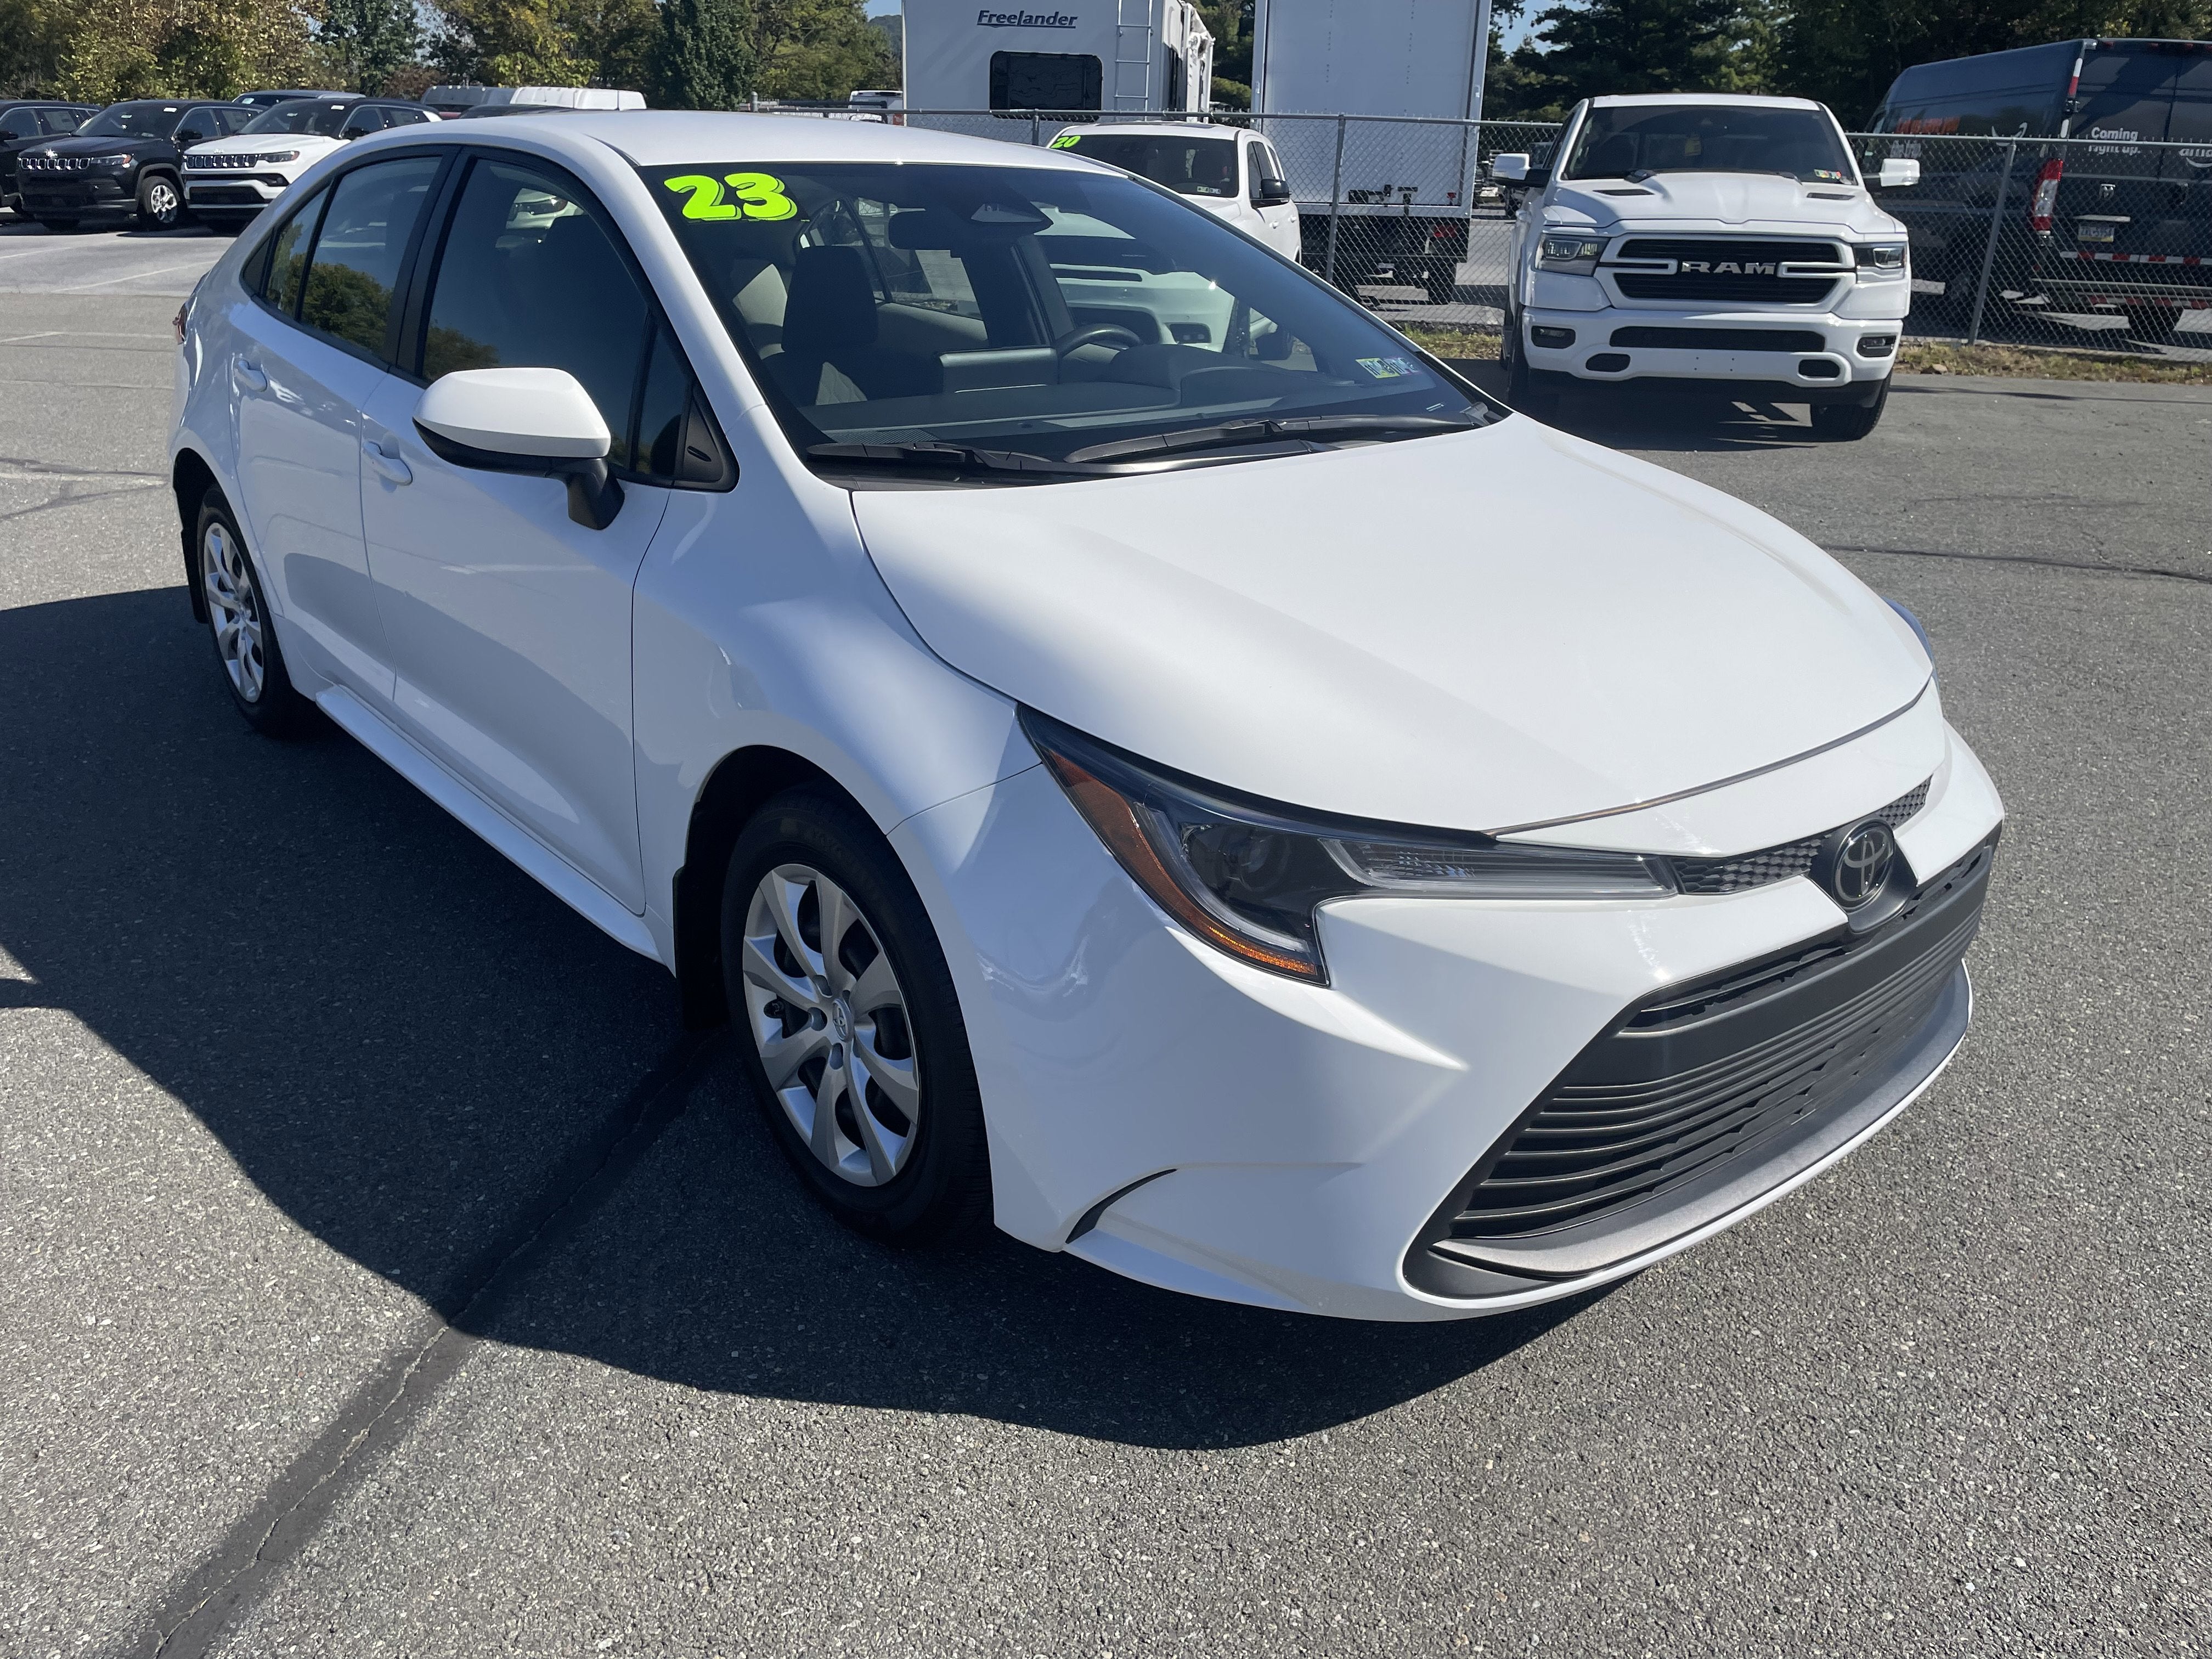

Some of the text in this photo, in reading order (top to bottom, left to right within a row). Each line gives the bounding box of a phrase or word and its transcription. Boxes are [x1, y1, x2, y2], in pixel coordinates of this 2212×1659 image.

[977, 10, 1078, 26] Freelander
[1050, 135, 1081, 149] 20
[2091, 127, 2139, 142] Coming
[663, 172, 798, 222] 23
[1681, 261, 1776, 275] RAM
